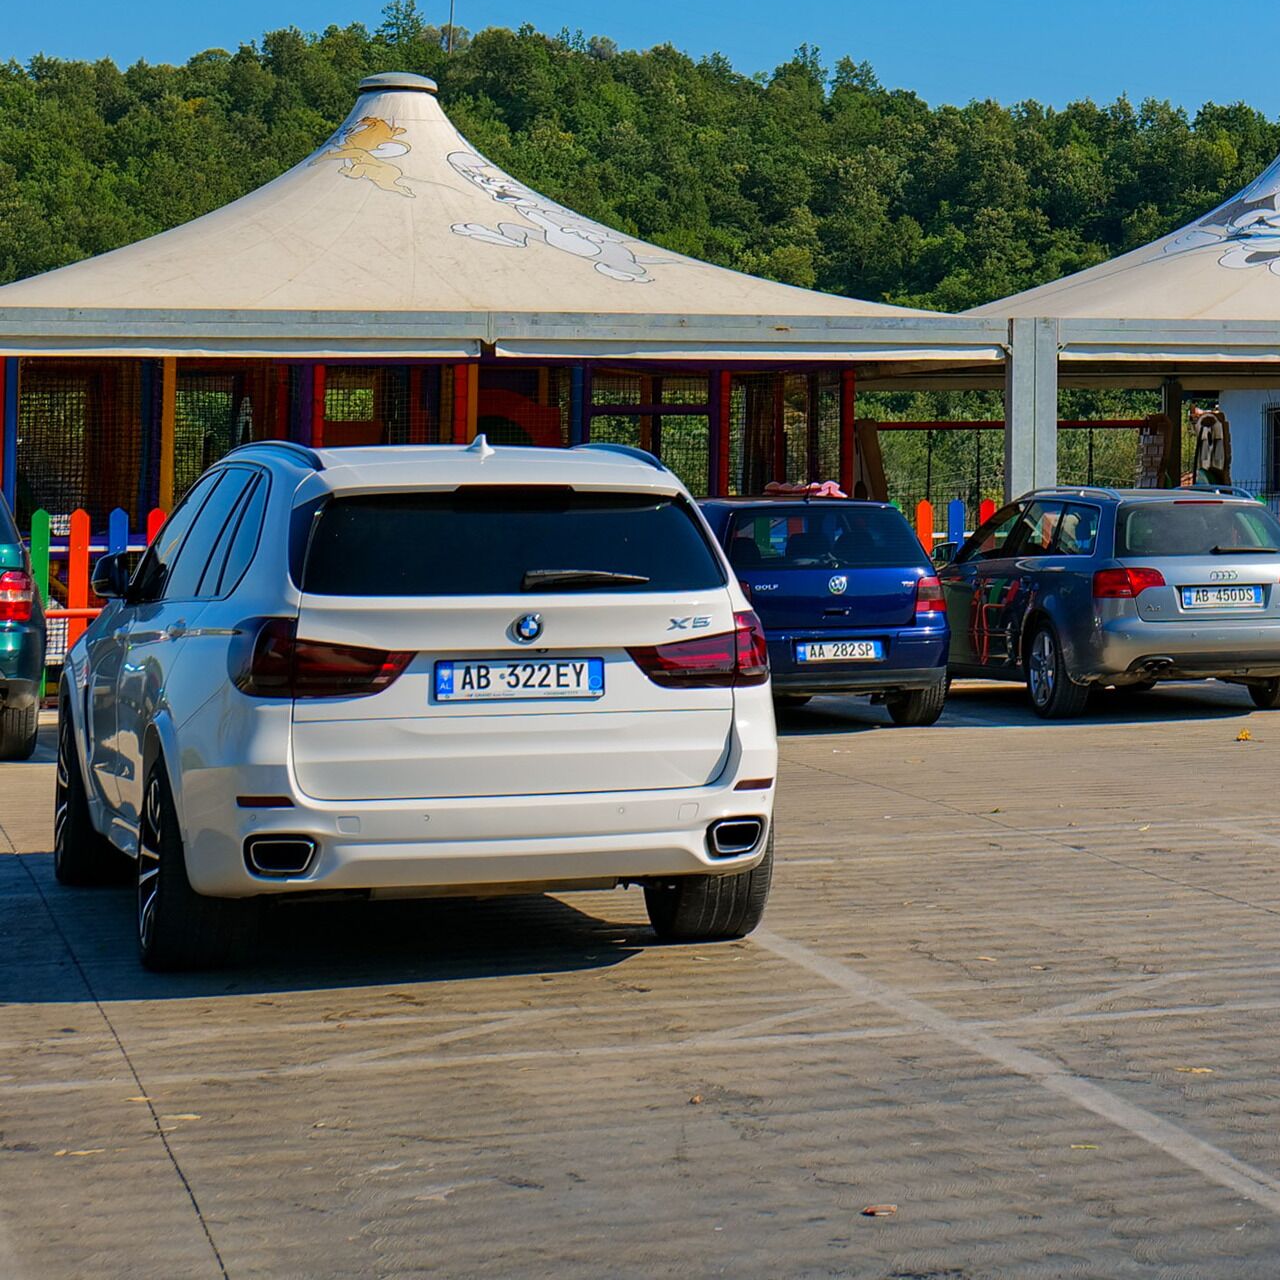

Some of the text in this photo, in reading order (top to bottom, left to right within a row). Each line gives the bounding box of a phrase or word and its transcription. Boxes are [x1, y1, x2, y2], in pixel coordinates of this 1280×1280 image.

[1195, 588, 1253, 603] AB 450DS
[666, 616, 712, 631] X5
[809, 641, 873, 658] AA 282SP
[461, 663, 585, 690] AB 322EY
